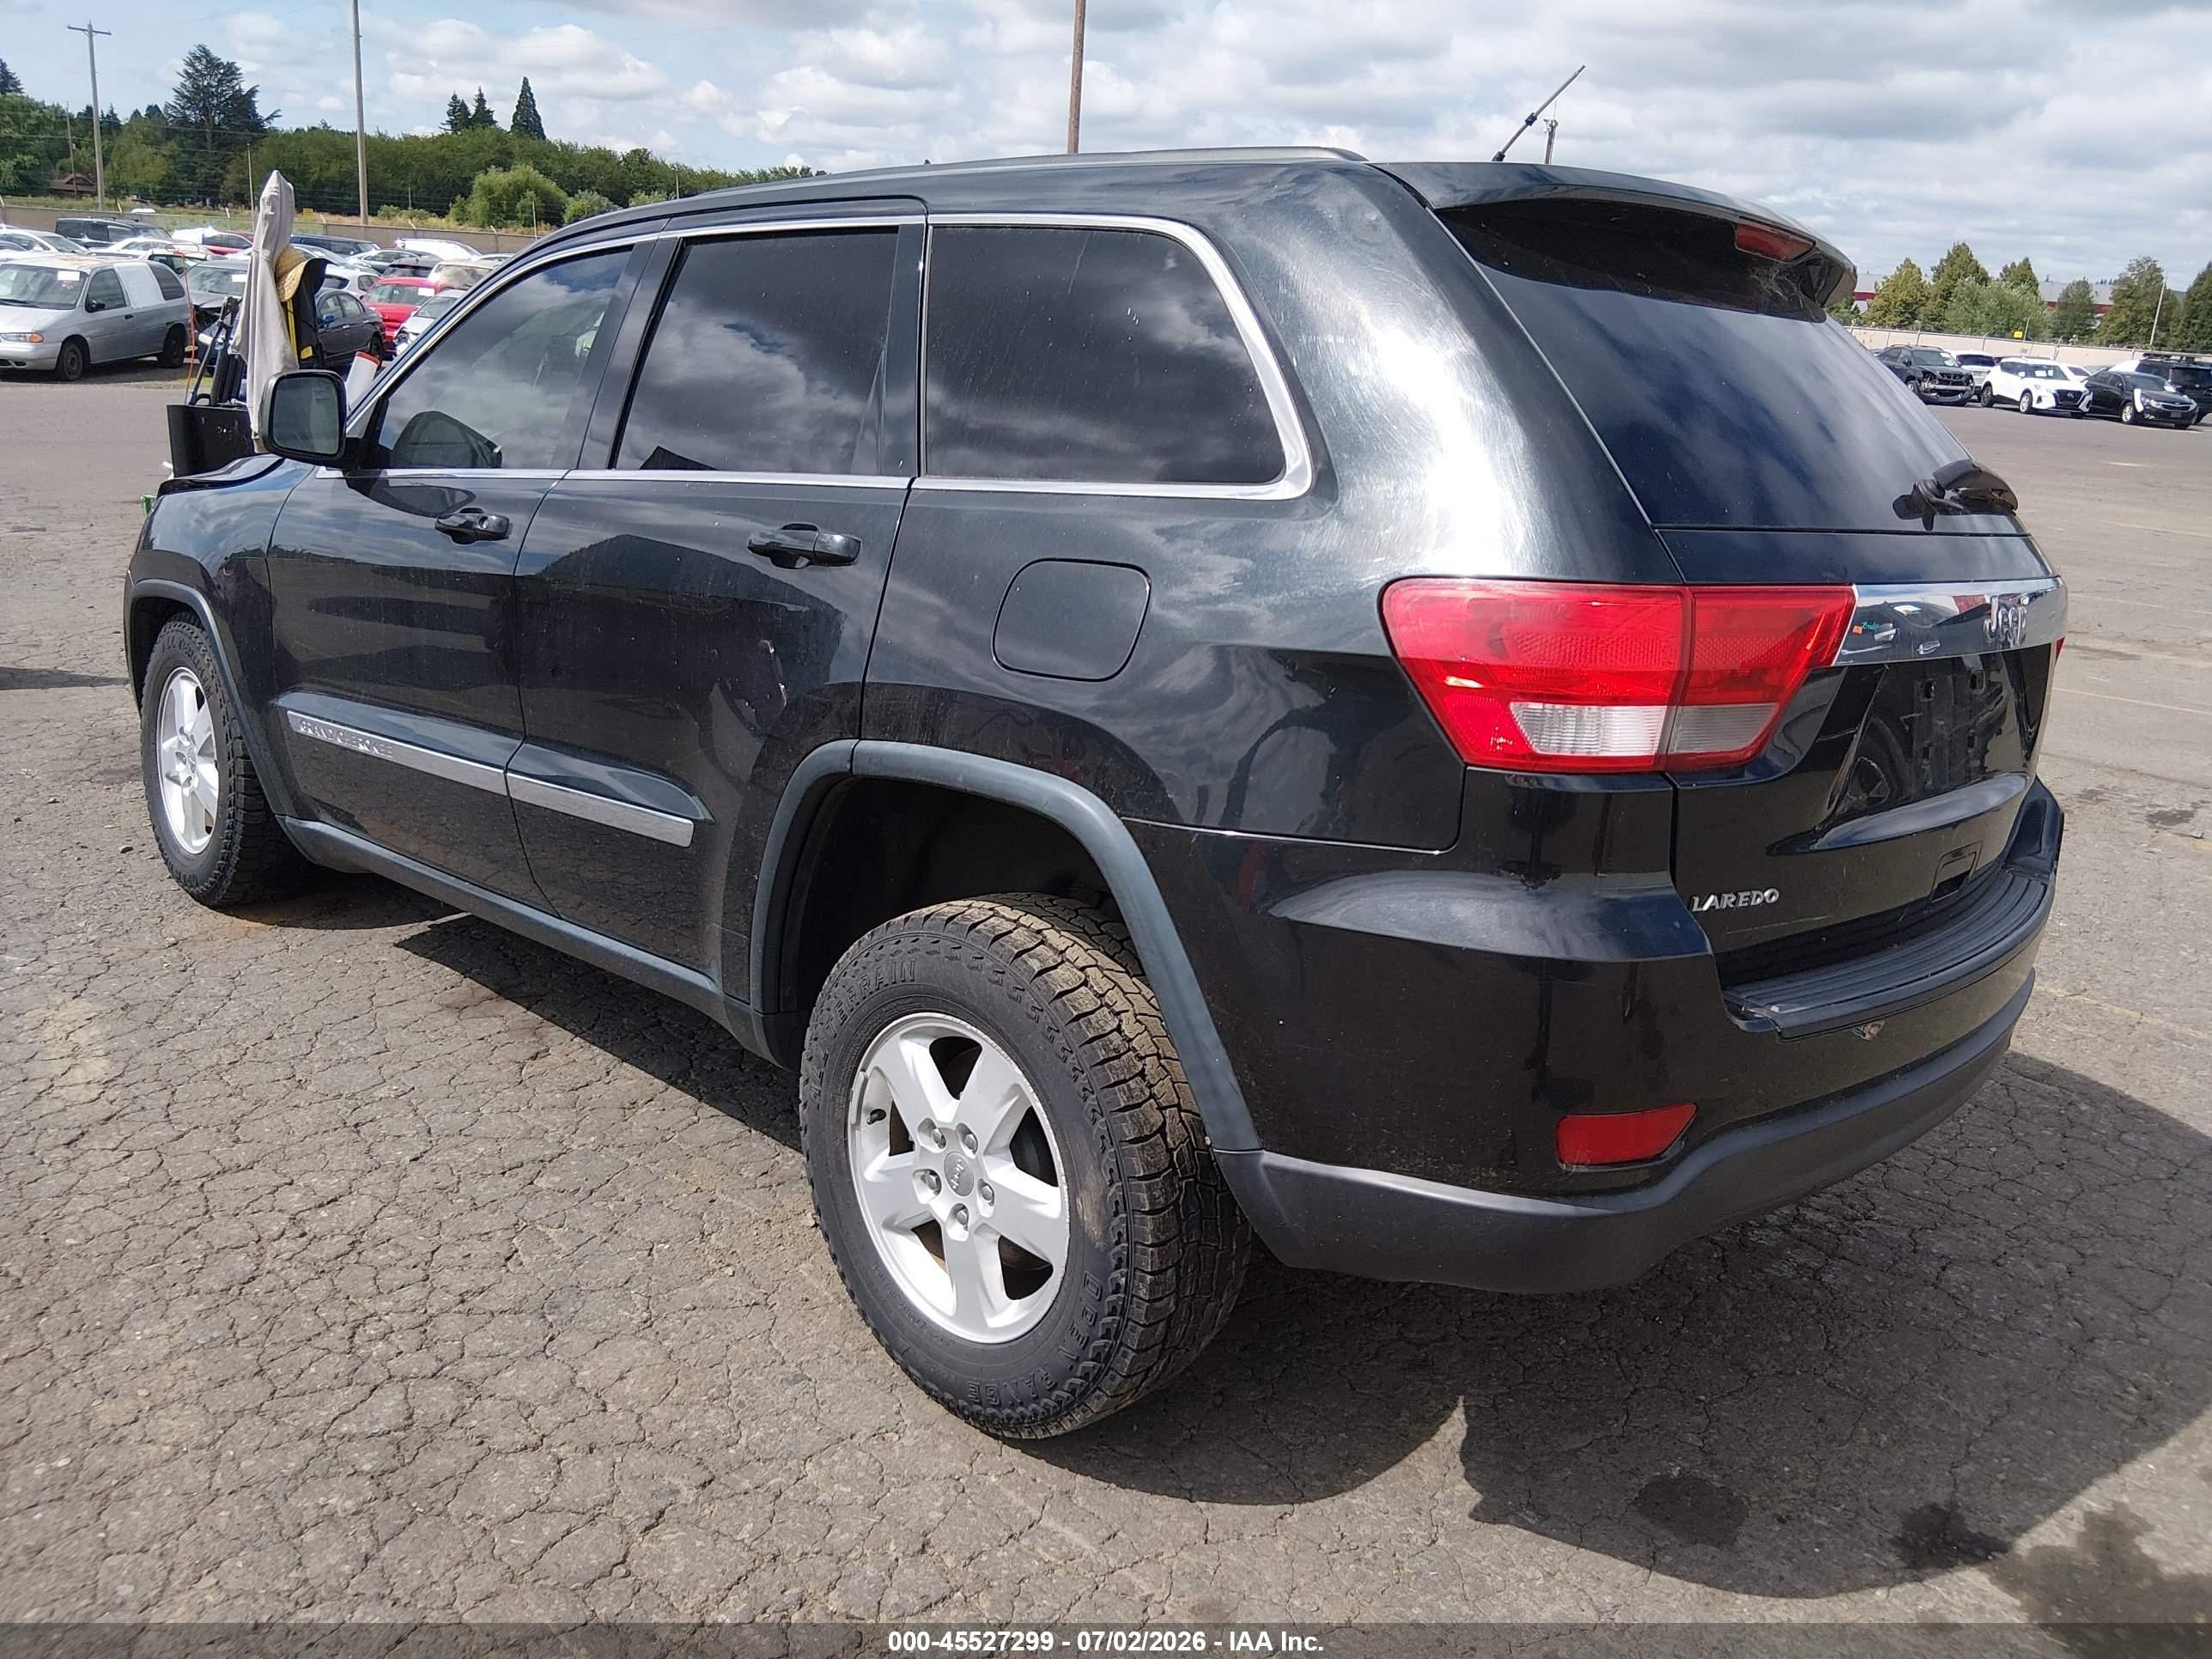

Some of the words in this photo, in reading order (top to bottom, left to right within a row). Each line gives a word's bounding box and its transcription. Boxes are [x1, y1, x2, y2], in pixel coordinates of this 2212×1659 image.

[1983, 595, 2027, 647] Jeep
[301, 720, 334, 741] GRAND
[336, 731, 395, 759] CHEROKEE
[1691, 887, 1780, 912] LAREDO
[809, 1046, 830, 1111] ALL
[825, 956, 916, 1039] TERRAIN
[1057, 1270, 1103, 1370] OPEN
[968, 1364, 1058, 1408] RANGE
